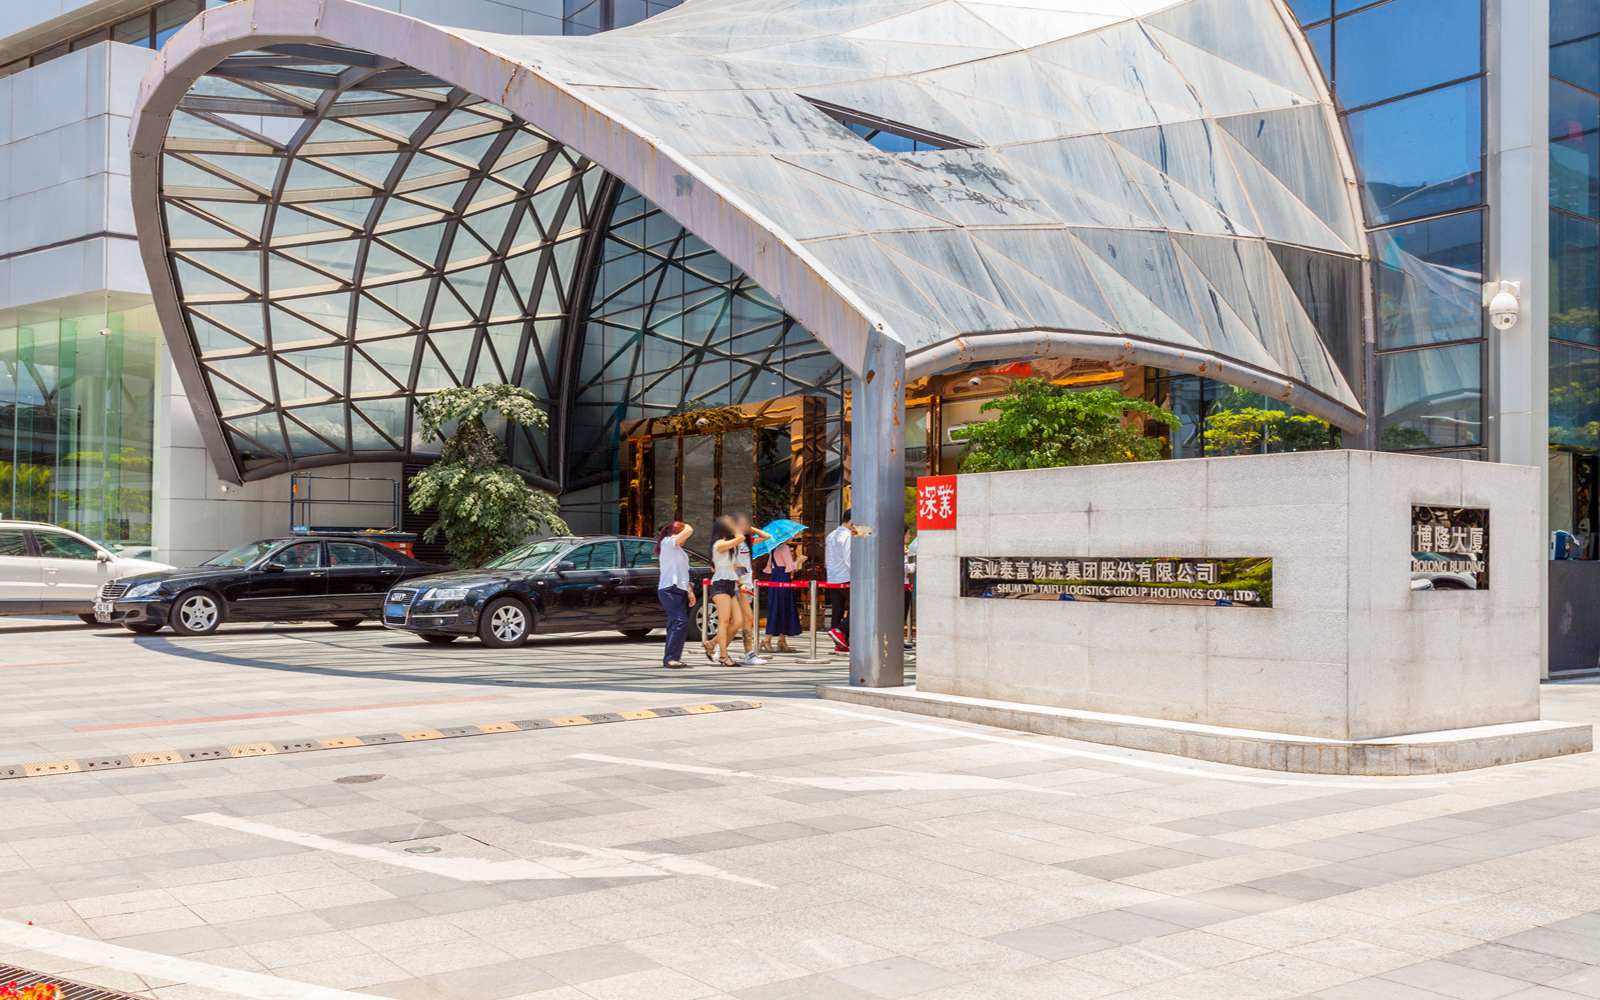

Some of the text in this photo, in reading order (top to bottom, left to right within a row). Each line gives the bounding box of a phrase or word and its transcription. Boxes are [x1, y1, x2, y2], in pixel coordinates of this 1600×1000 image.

[969, 561, 1216, 584] 深业泰富物流集团股份有限公司
[1412, 560, 1485, 573] BOLONG BUILDING
[997, 583, 1022, 593] SHUM
[1023, 584, 1037, 594] YIP
[1065, 584, 1111, 596] LOGISTICS
[1113, 586, 1147, 597] GROUP
[1149, 587, 1204, 599] HOLDINGS
